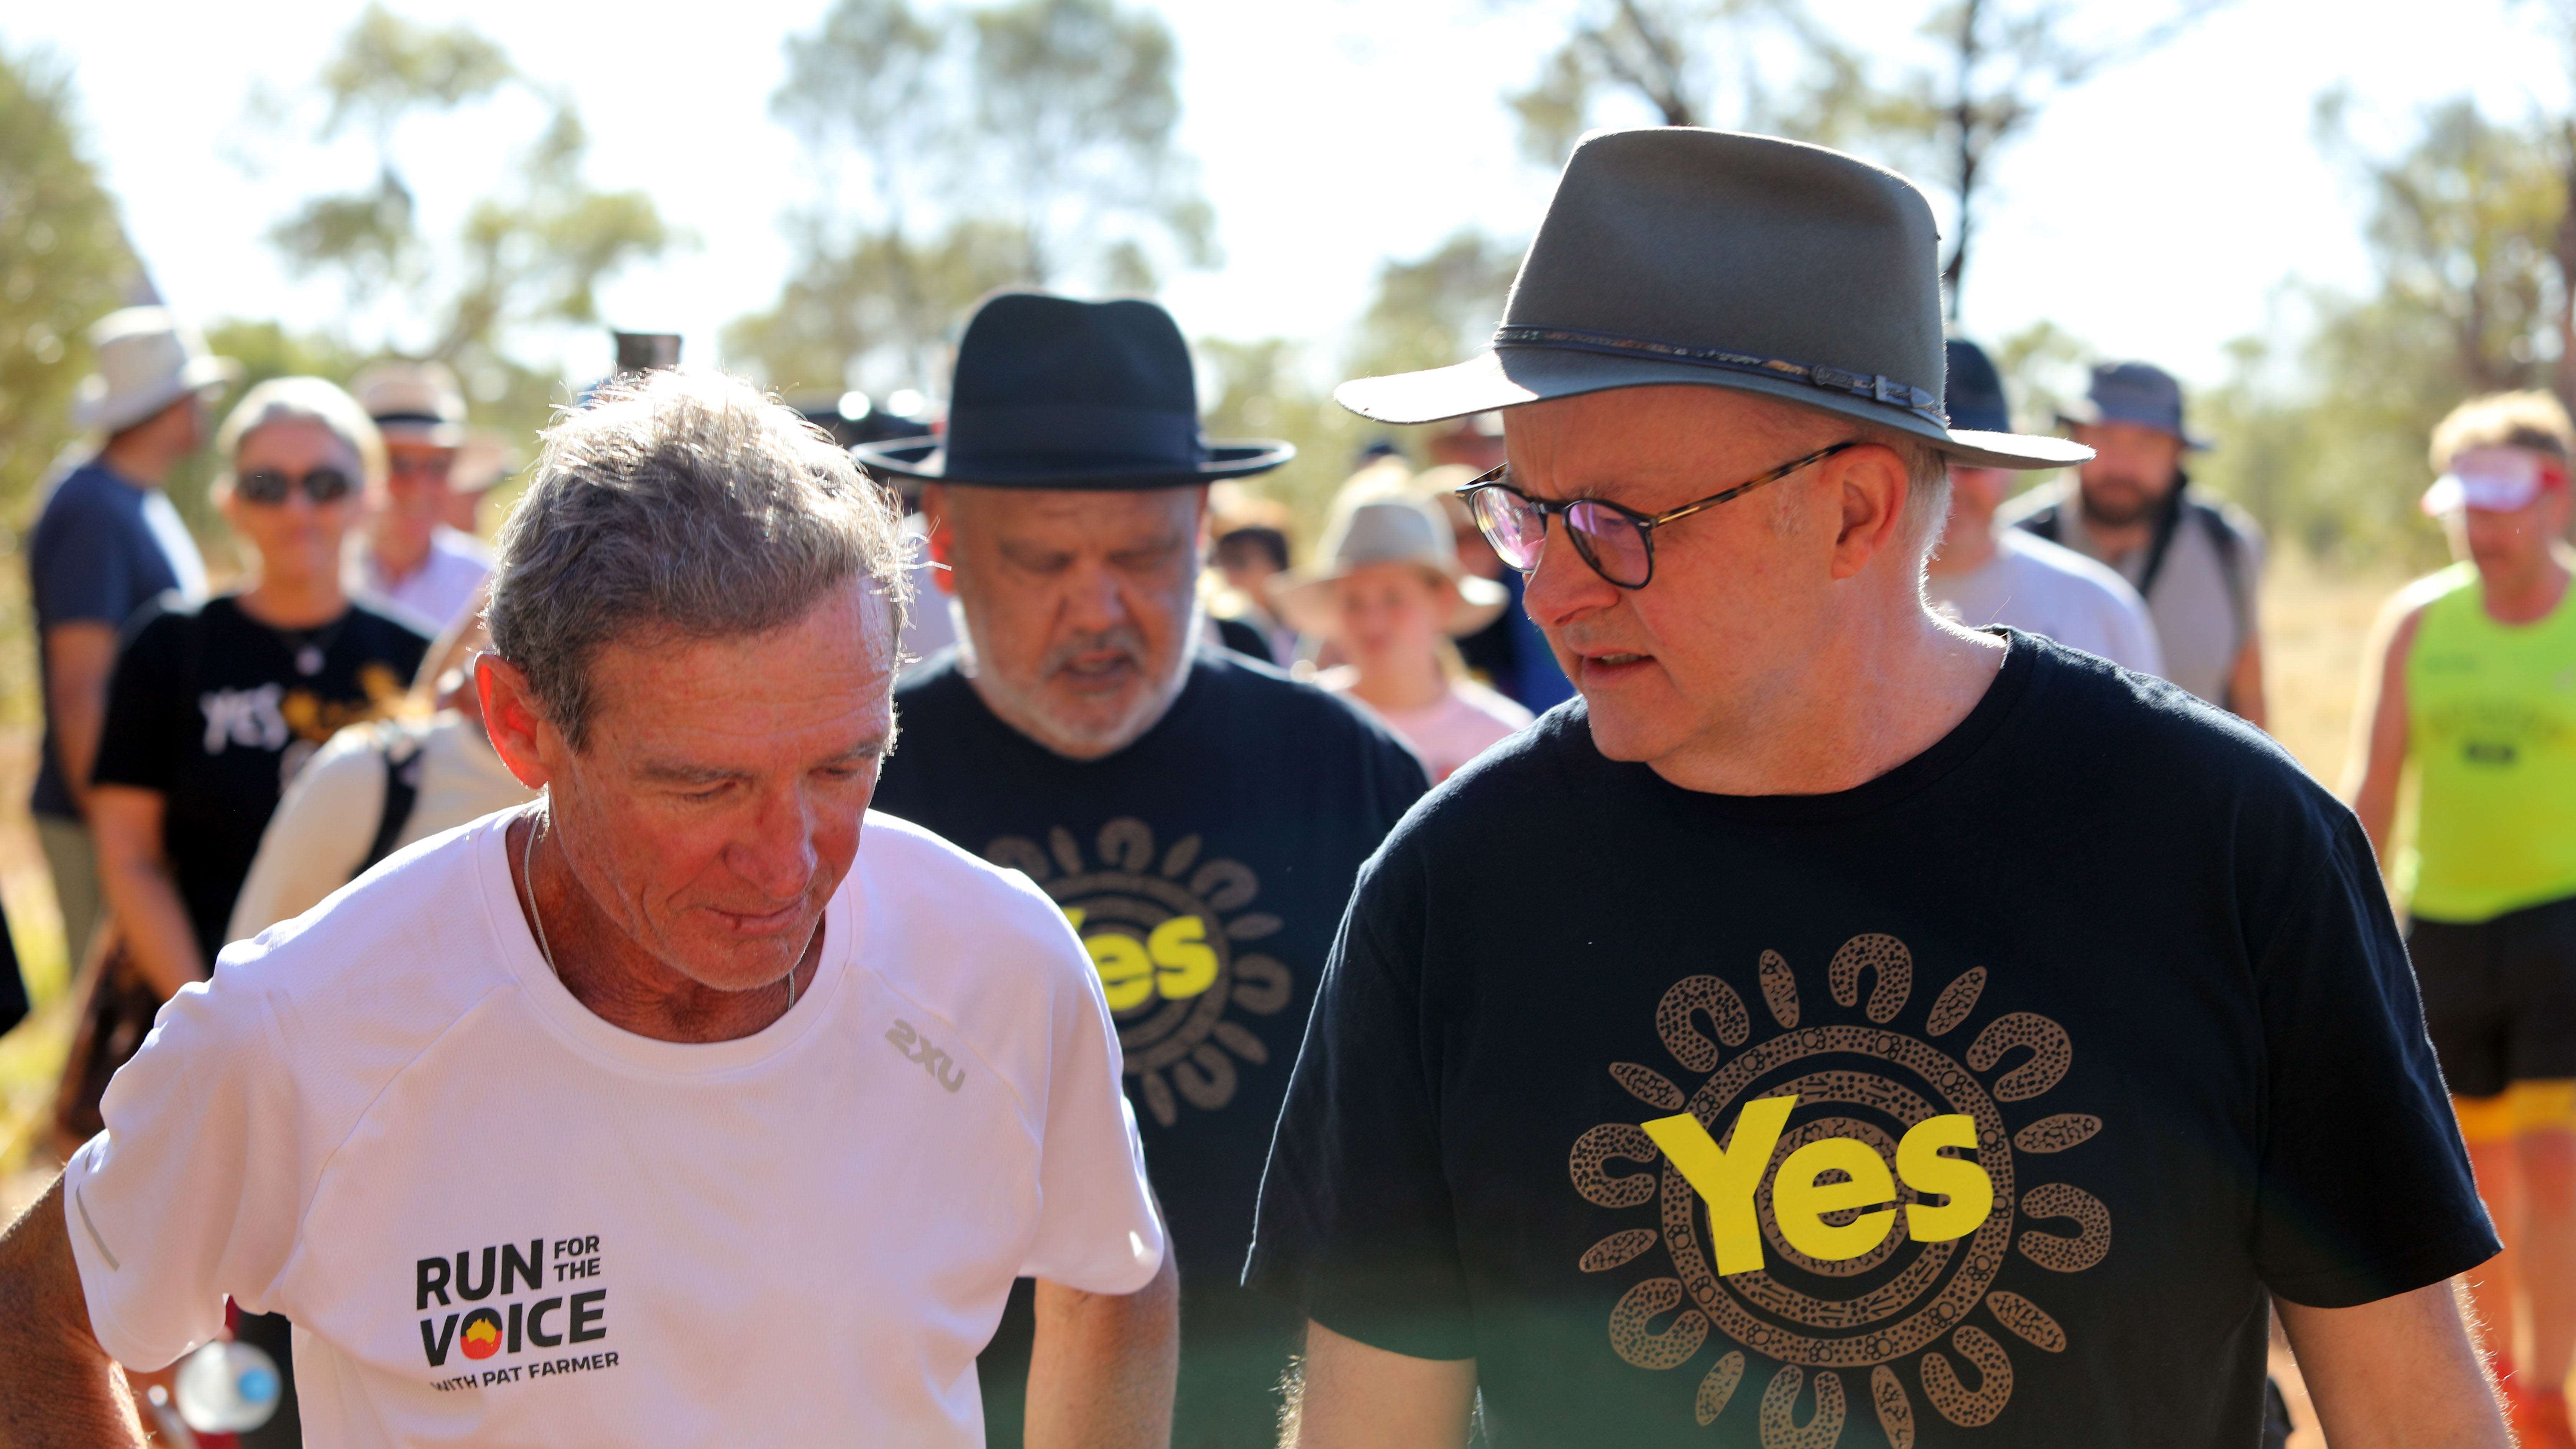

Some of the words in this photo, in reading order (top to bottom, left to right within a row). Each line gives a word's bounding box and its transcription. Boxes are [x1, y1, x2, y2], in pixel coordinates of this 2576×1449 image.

[198, 682, 289, 755] YES
[1062, 907, 1219, 1011] es
[885, 1019, 966, 1093] 2XU
[1640, 1094, 1993, 1276] Yes
[417, 1238, 543, 1310] RUN
[554, 1235, 600, 1259] FOR
[554, 1258, 601, 1282] THE
[420, 1288, 607, 1367] VOICE
[430, 1373, 478, 1392] WITH
[483, 1367, 522, 1386] PAT
[529, 1352, 619, 1378] FARMER
